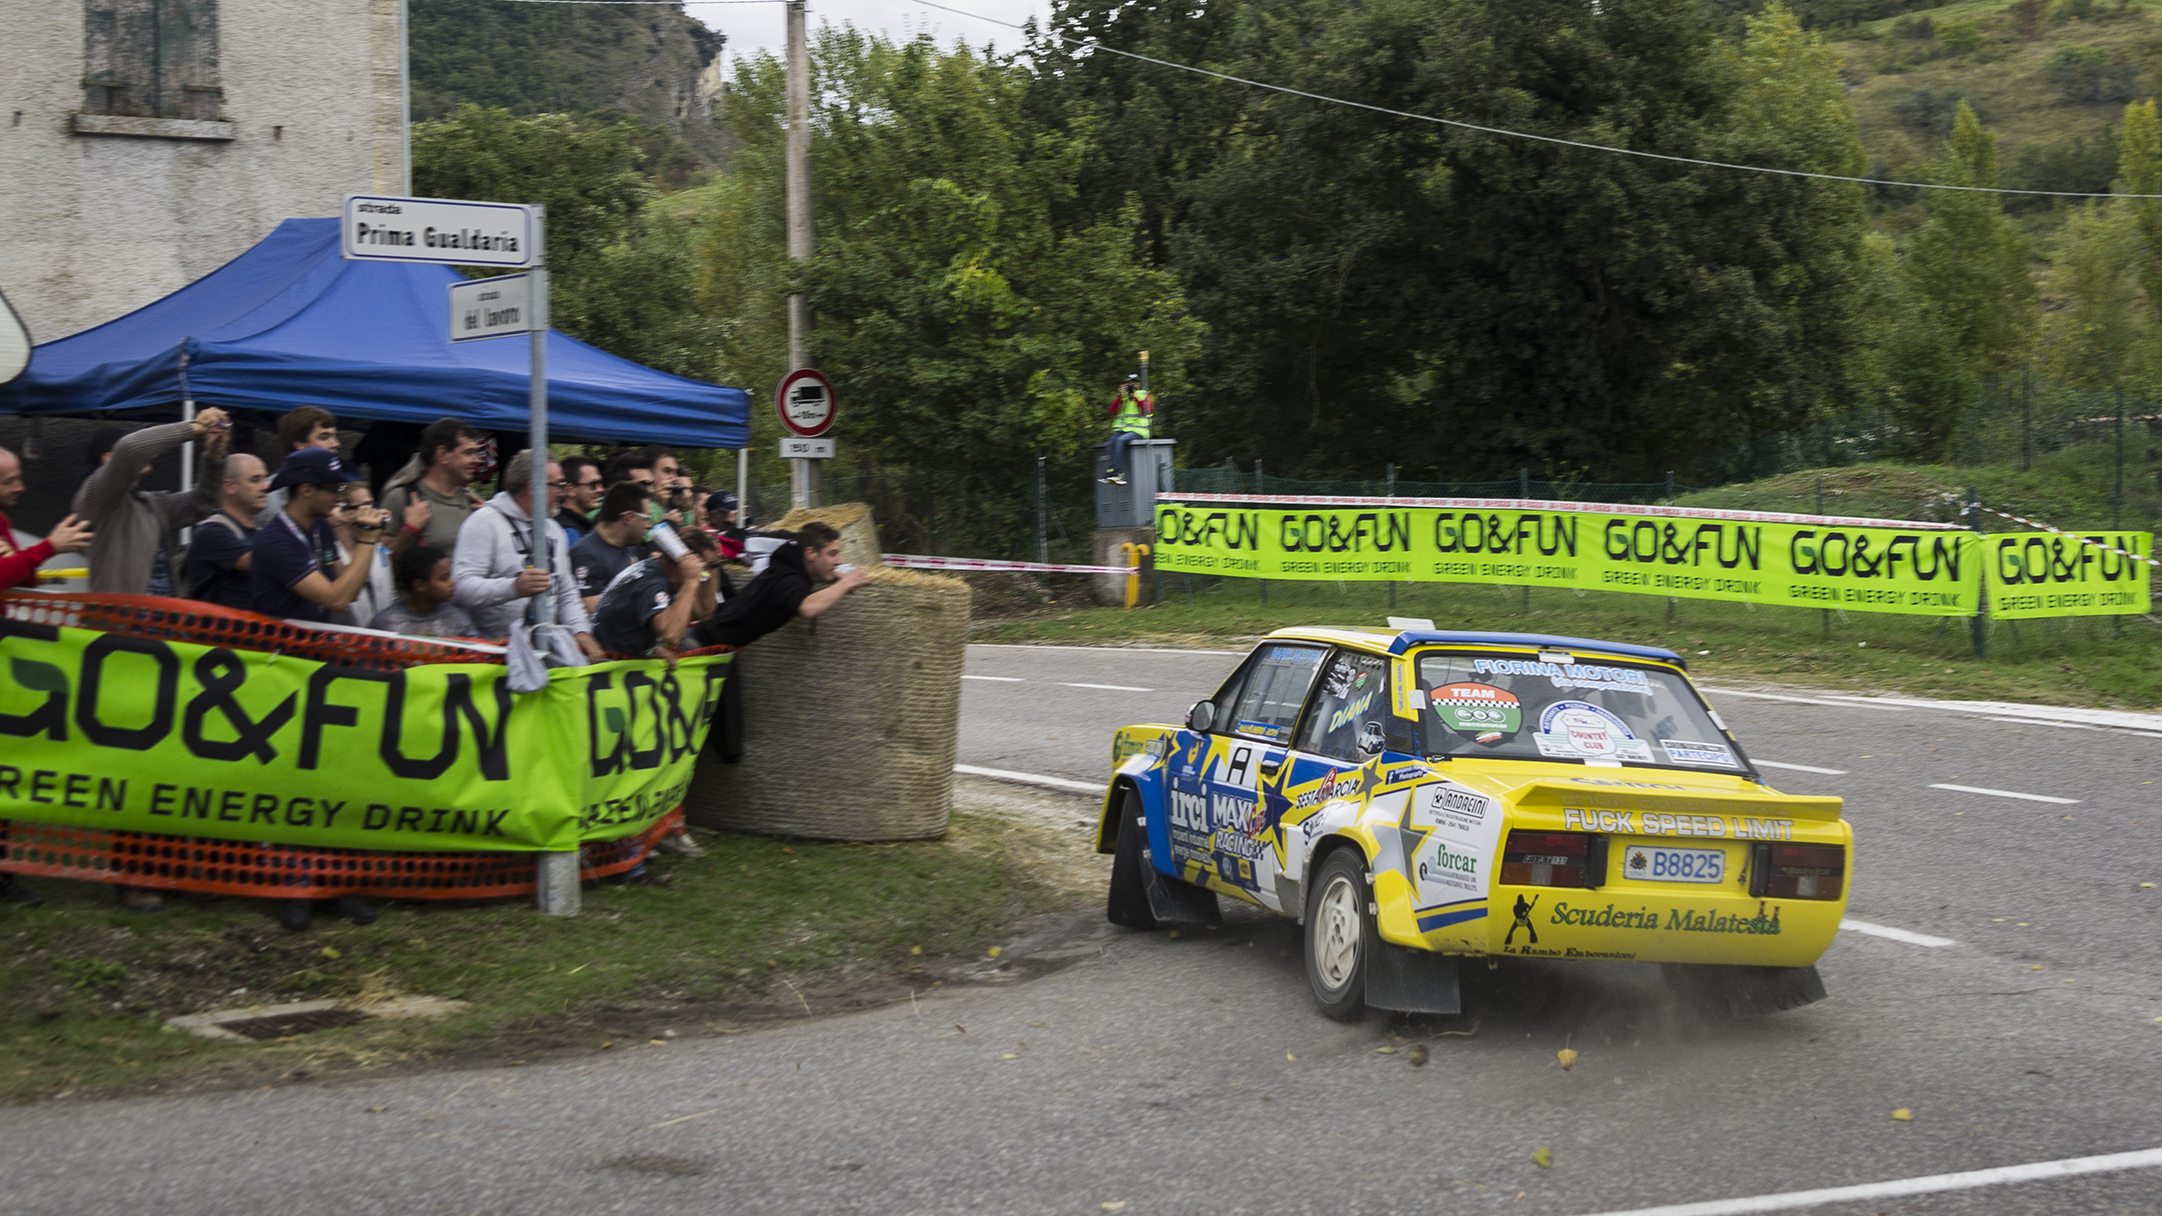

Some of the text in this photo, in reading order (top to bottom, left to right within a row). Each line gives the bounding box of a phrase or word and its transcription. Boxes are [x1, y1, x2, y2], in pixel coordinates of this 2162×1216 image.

[357, 203, 402, 214] strada
[357, 222, 520, 252] Prima Gualdaria
[1155, 509, 1258, 550] O&FUN
[1281, 513, 1410, 551] GO&FUN
[1435, 513, 1578, 557] GO&FUN
[1604, 519, 1761, 570] GO&FUN
[1791, 531, 1963, 581] GO&FUN
[1474, 659, 1650, 685] FIORINA MOTORI
[1451, 688, 1495, 699] TEAM
[1328, 690, 1374, 734] DIANA
[1458, 721, 1508, 729] meccanocar
[1570, 730, 1607, 741] COUNTRY
[1584, 741, 1604, 750] CLUB
[1227, 747, 1252, 785] A
[0, 764, 510, 836] REEN ENERGY DRINK
[1171, 776, 1209, 833] irci
[1212, 792, 1254, 833] MAXI
[1445, 793, 1486, 815] ANDREINI
[1563, 808, 1795, 841] FUCK SPEED LIMIT
[1215, 830, 1254, 859] RACING
[1438, 844, 1477, 873] forcar
[1652, 851, 1721, 879] B8825
[1550, 902, 1781, 935] Scuderia Malatesta
